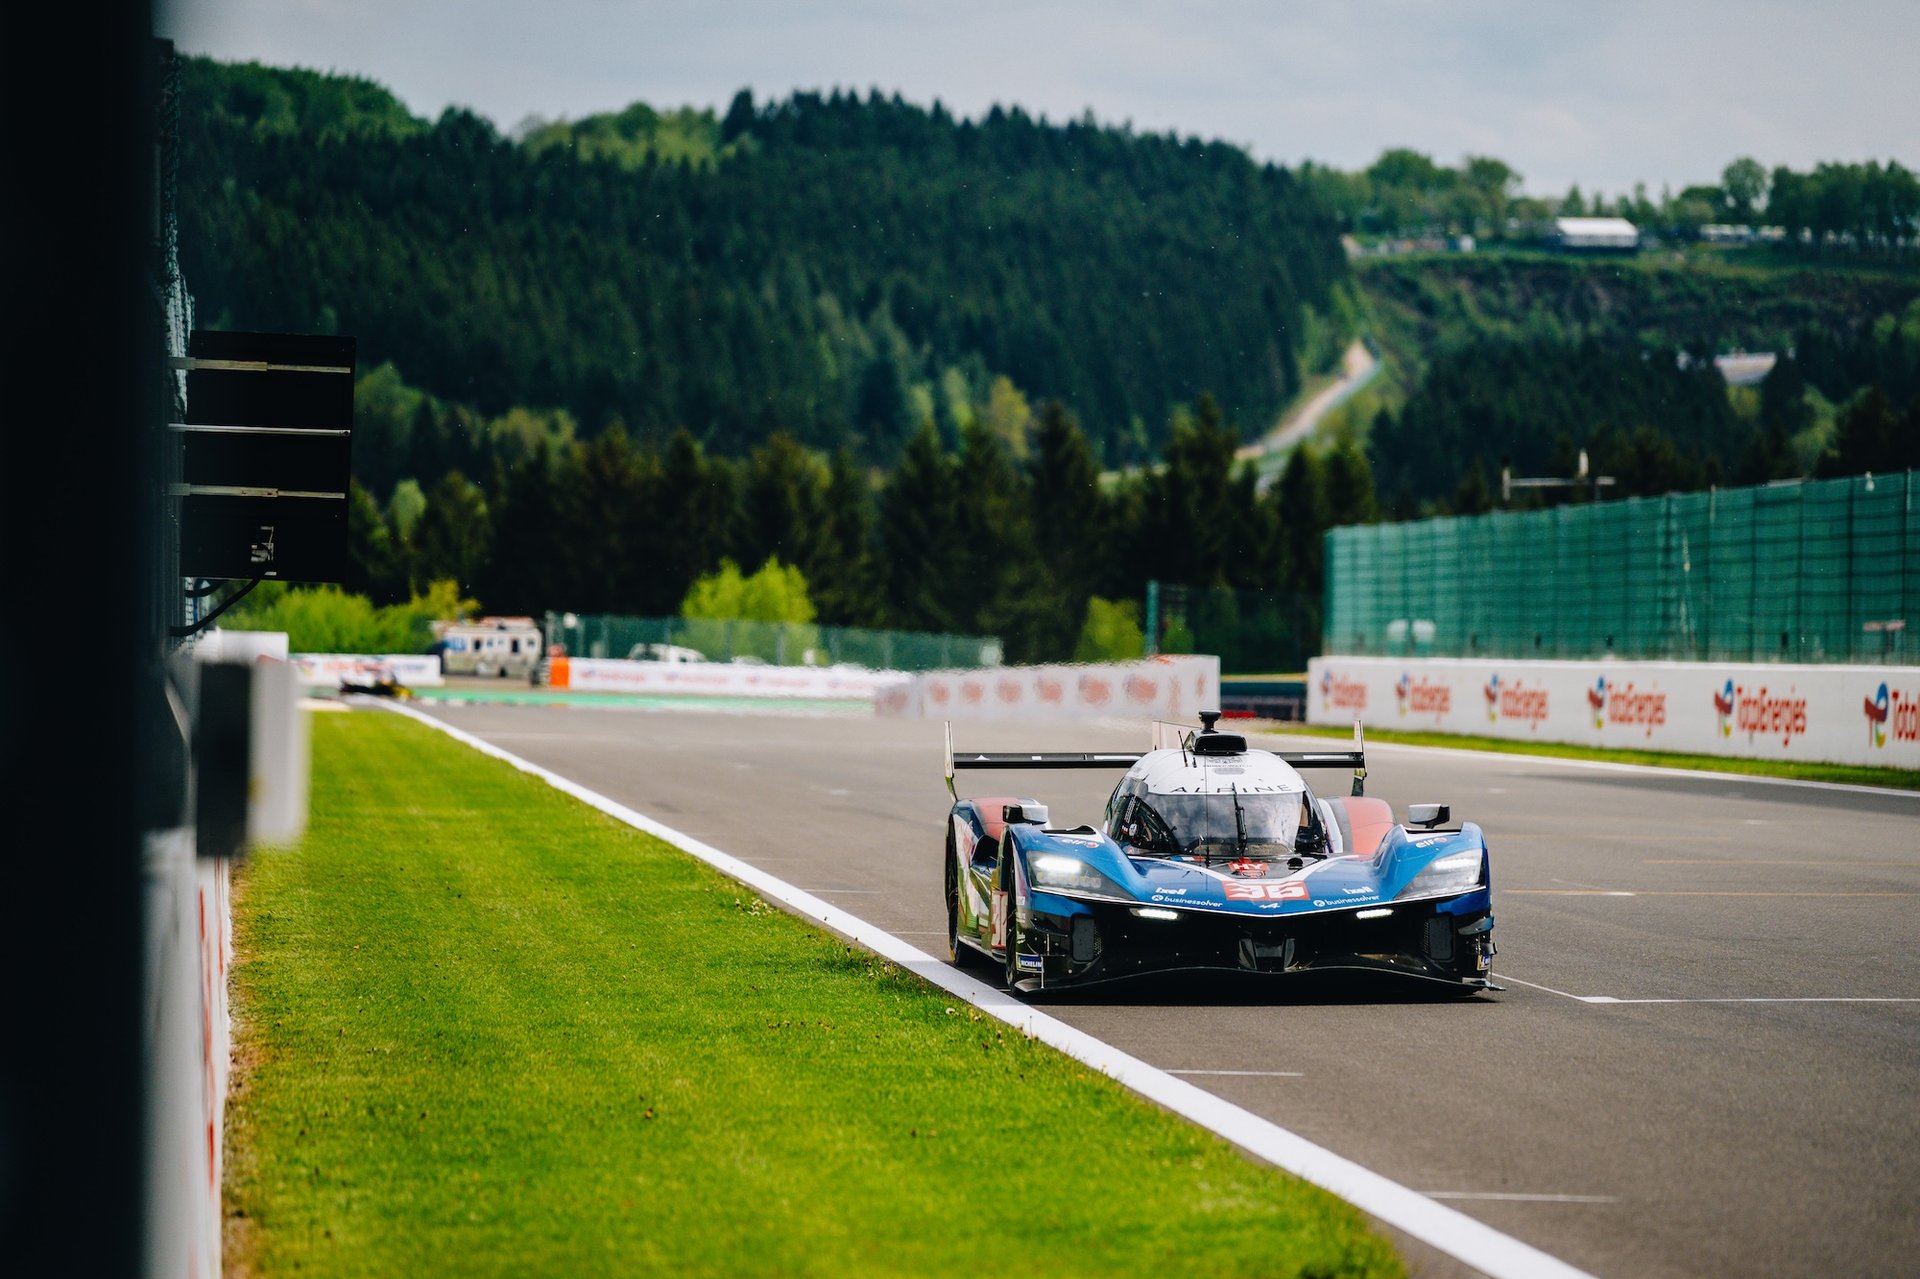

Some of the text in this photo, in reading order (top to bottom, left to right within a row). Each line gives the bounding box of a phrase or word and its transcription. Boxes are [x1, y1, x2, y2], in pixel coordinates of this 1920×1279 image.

[1736, 684, 1808, 748] TotalEnergies
[1170, 784, 1293, 793] ALPINE
[1225, 881, 1306, 899] 36
[1164, 896, 1224, 908] businessolver
[1324, 895, 1380, 906] businessolver
